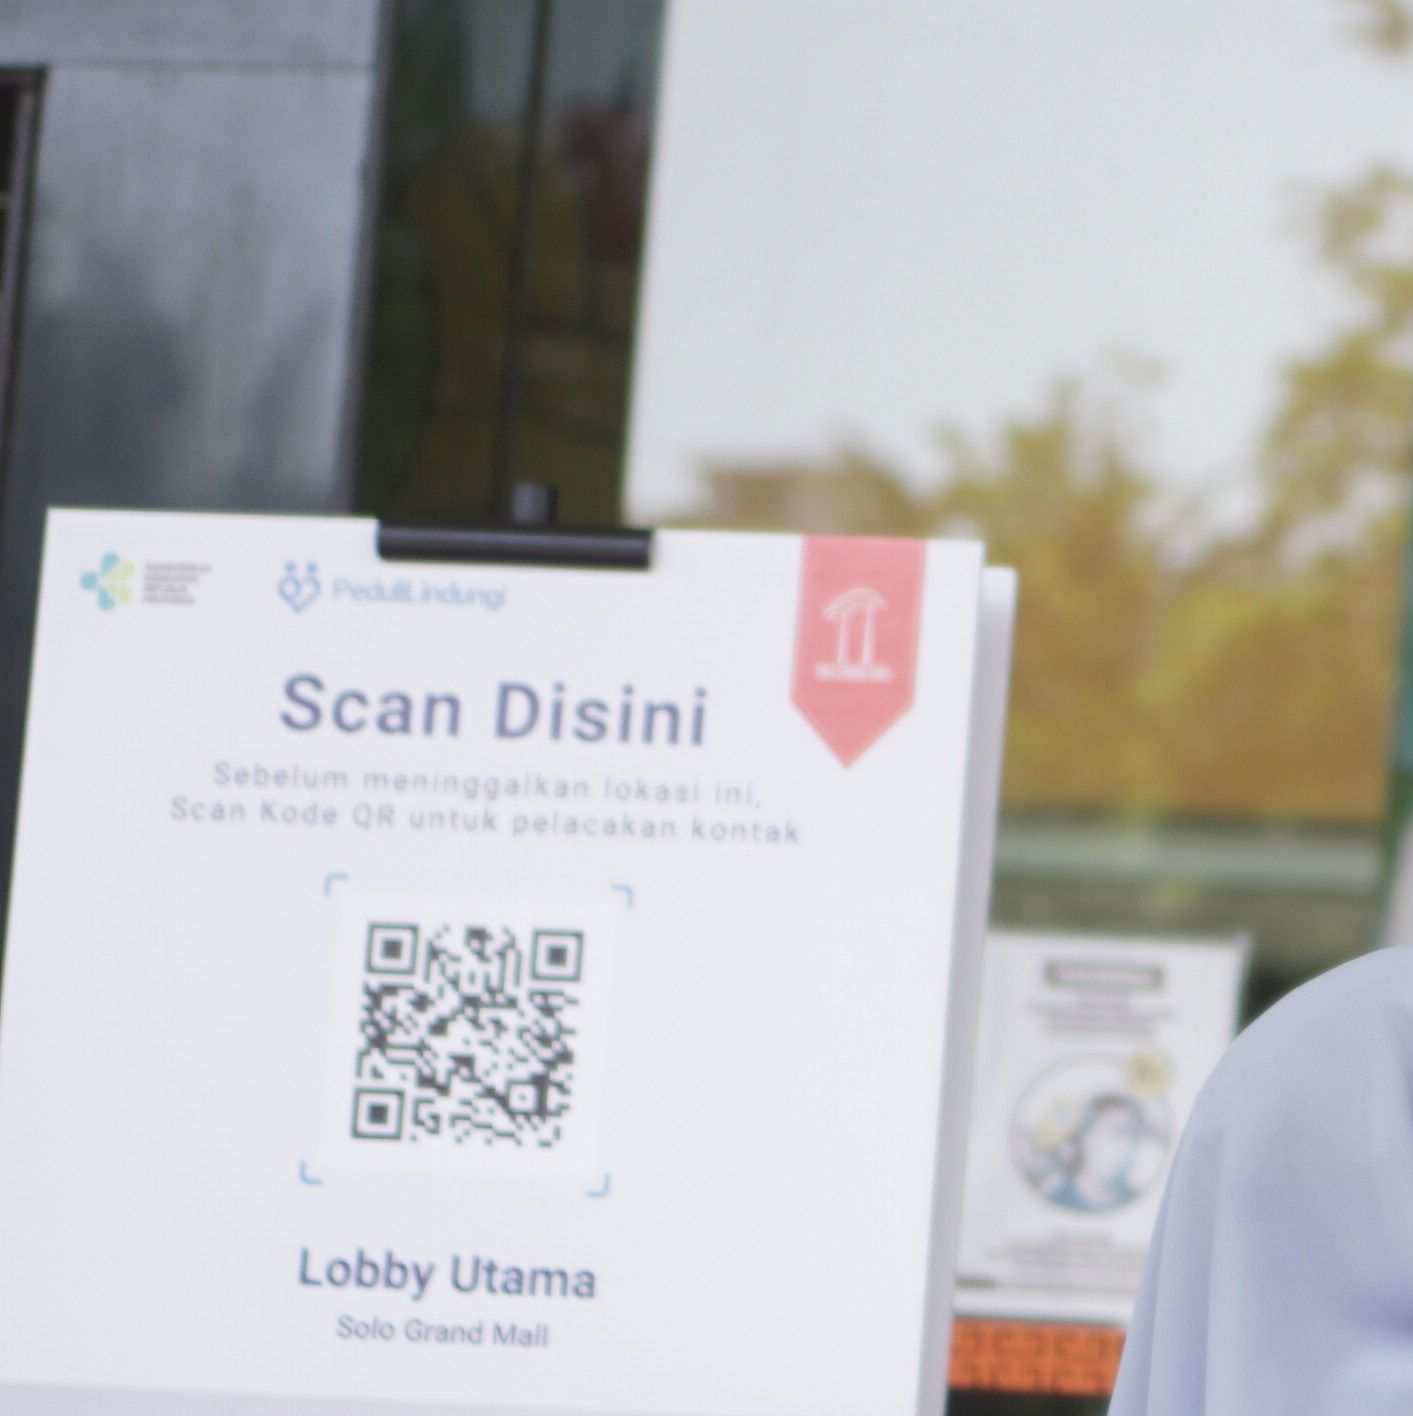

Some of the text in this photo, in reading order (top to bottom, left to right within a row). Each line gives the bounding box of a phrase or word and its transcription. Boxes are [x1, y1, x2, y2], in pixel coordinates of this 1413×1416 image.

[281, 676, 707, 745] Scan Disini
[169, 795, 800, 845] Scan Kode QR untuk pelacakan kontak
[297, 1249, 597, 1300] Lobby Utama
[336, 1314, 550, 1348] Solo Grand Mall
